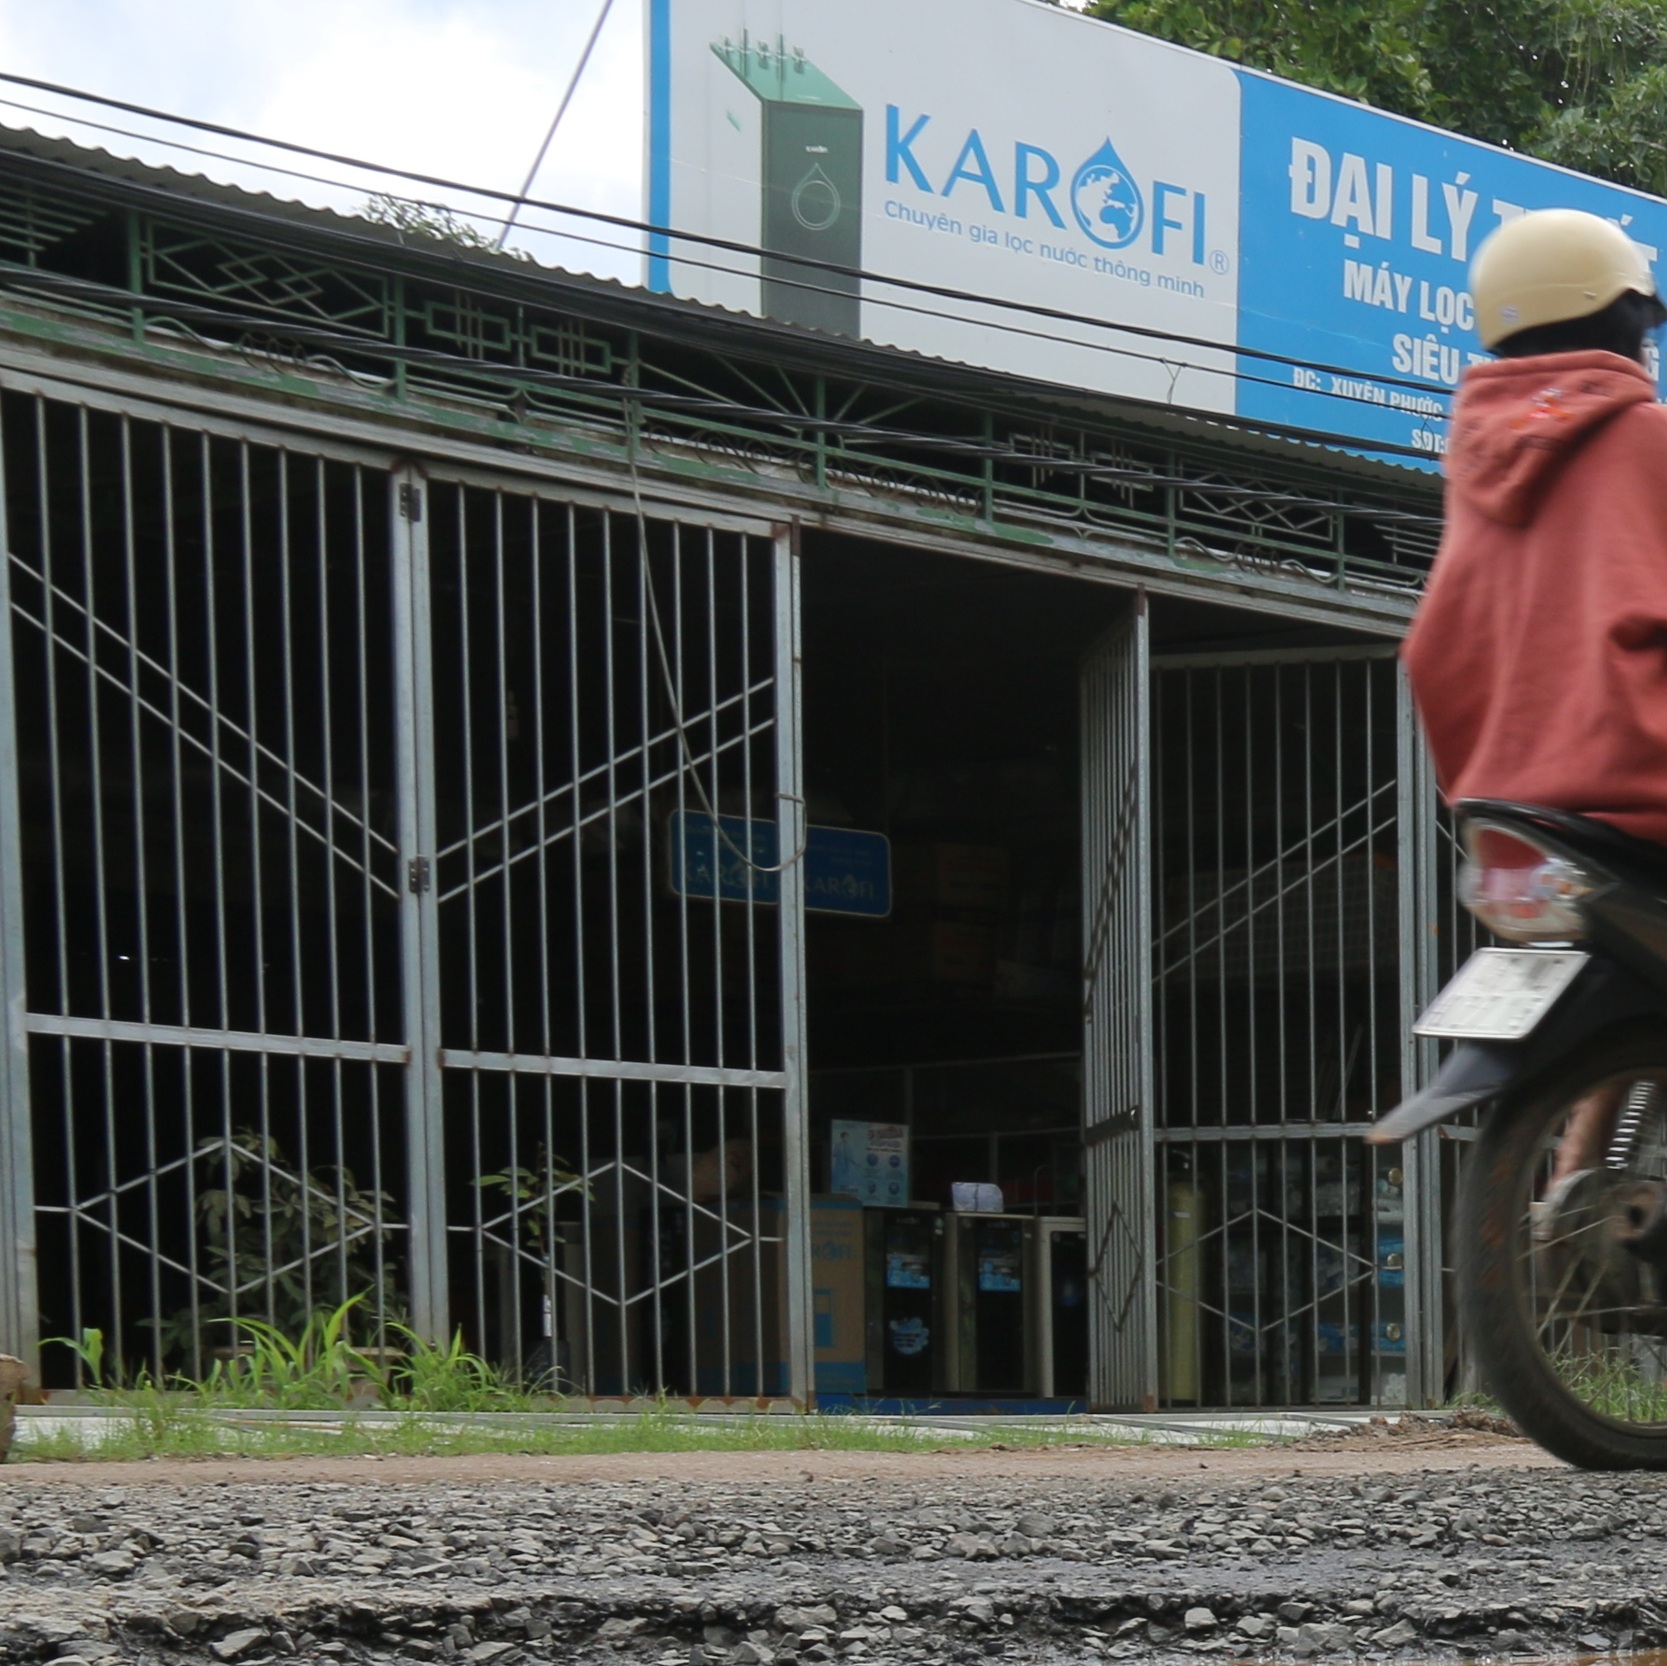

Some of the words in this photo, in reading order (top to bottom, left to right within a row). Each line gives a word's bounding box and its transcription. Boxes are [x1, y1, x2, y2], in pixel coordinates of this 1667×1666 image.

[885, 103, 1206, 266] KAROFI
[1288, 136, 1393, 249] ĐẠI
[1411, 171, 1479, 263] LÝ
[884, 200, 963, 236] Chuyên
[969, 222, 999, 244] gia
[1005, 231, 1034, 254] lọc
[1040, 242, 1088, 268] nước
[1094, 255, 1151, 287] thông
[1157, 274, 1206, 299] minh
[1344, 258, 1413, 314] MÁY
[1419, 280, 1476, 335] LỌC
[1392, 333, 1460, 386] SIÊU
